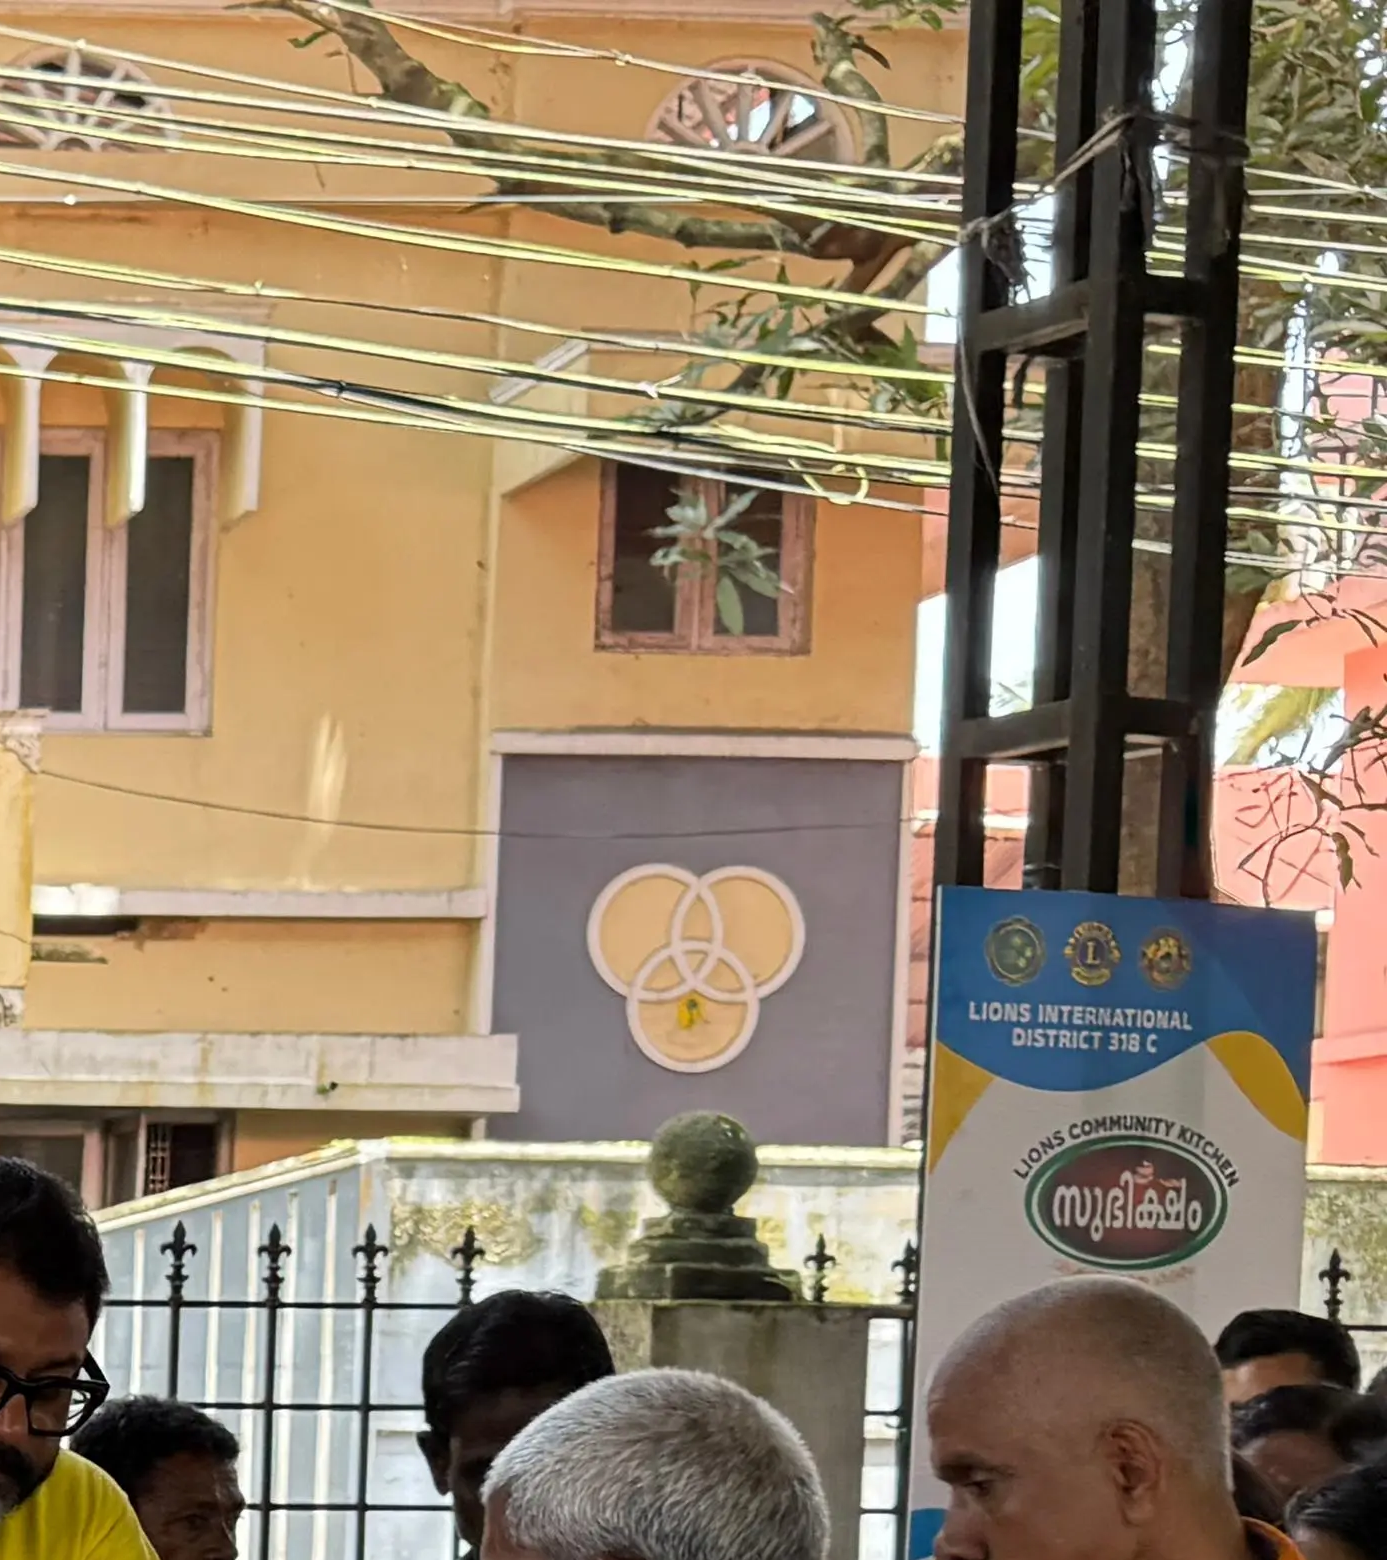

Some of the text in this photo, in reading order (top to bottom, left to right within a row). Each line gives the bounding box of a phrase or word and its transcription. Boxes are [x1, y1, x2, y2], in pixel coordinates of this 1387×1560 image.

[969, 1001, 1193, 1031] LIONS INTERNATIONAL
[1012, 1028, 1158, 1053] DISTRICT 318 C
[1013, 1115, 1240, 1187] LIONS COMMUNITY KITCHEN
[1052, 1170, 1202, 1242] സുഭിക്ഷം
